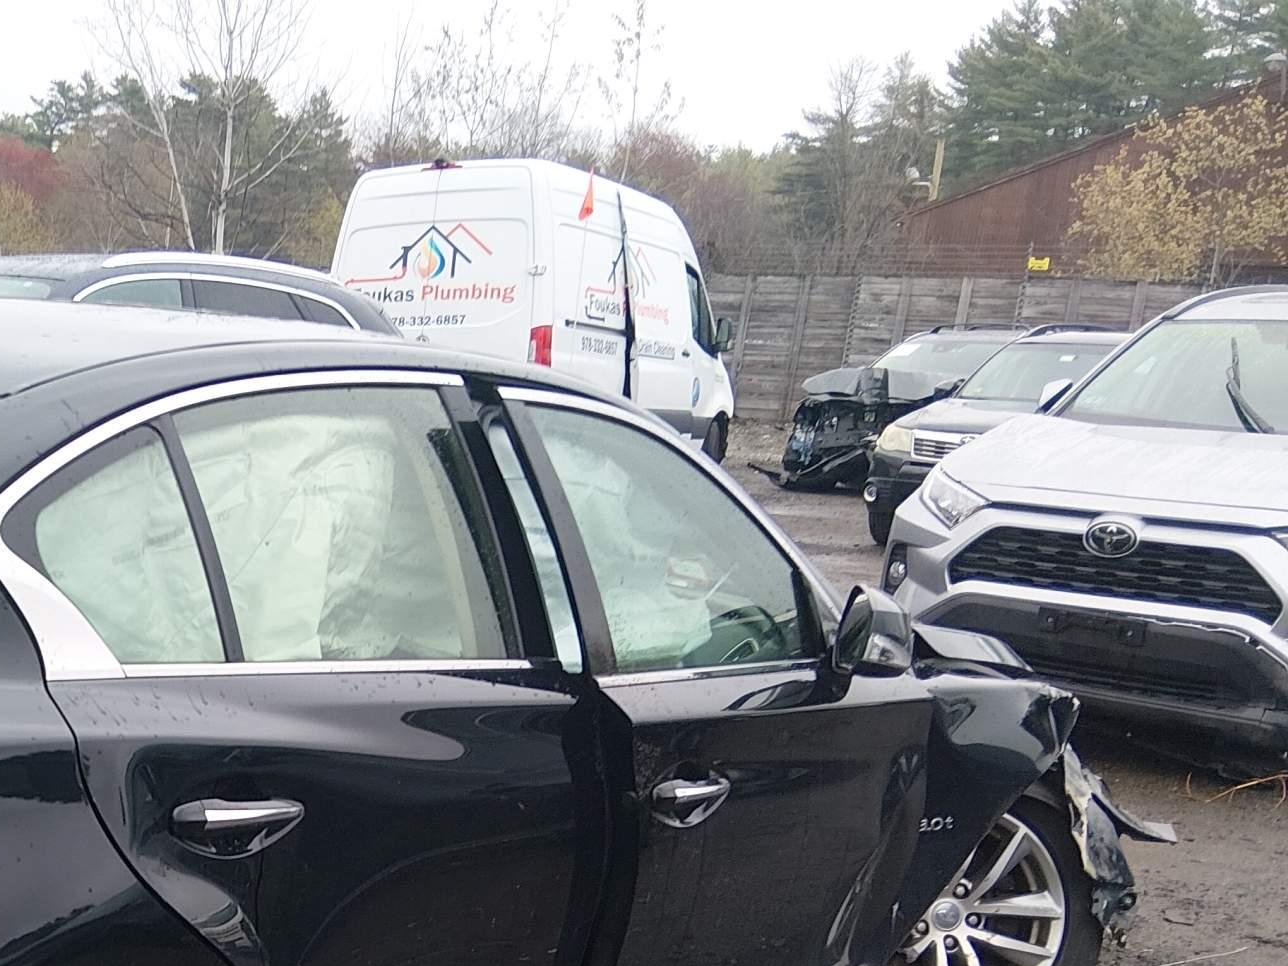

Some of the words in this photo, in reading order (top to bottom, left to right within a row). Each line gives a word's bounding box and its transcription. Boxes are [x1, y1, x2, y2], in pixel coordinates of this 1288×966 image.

[353, 286, 415, 303] ukas
[421, 283, 517, 303] Plumbing
[589, 294, 621, 317] Foukas
[391, 314, 466, 328] 78-332-6857
